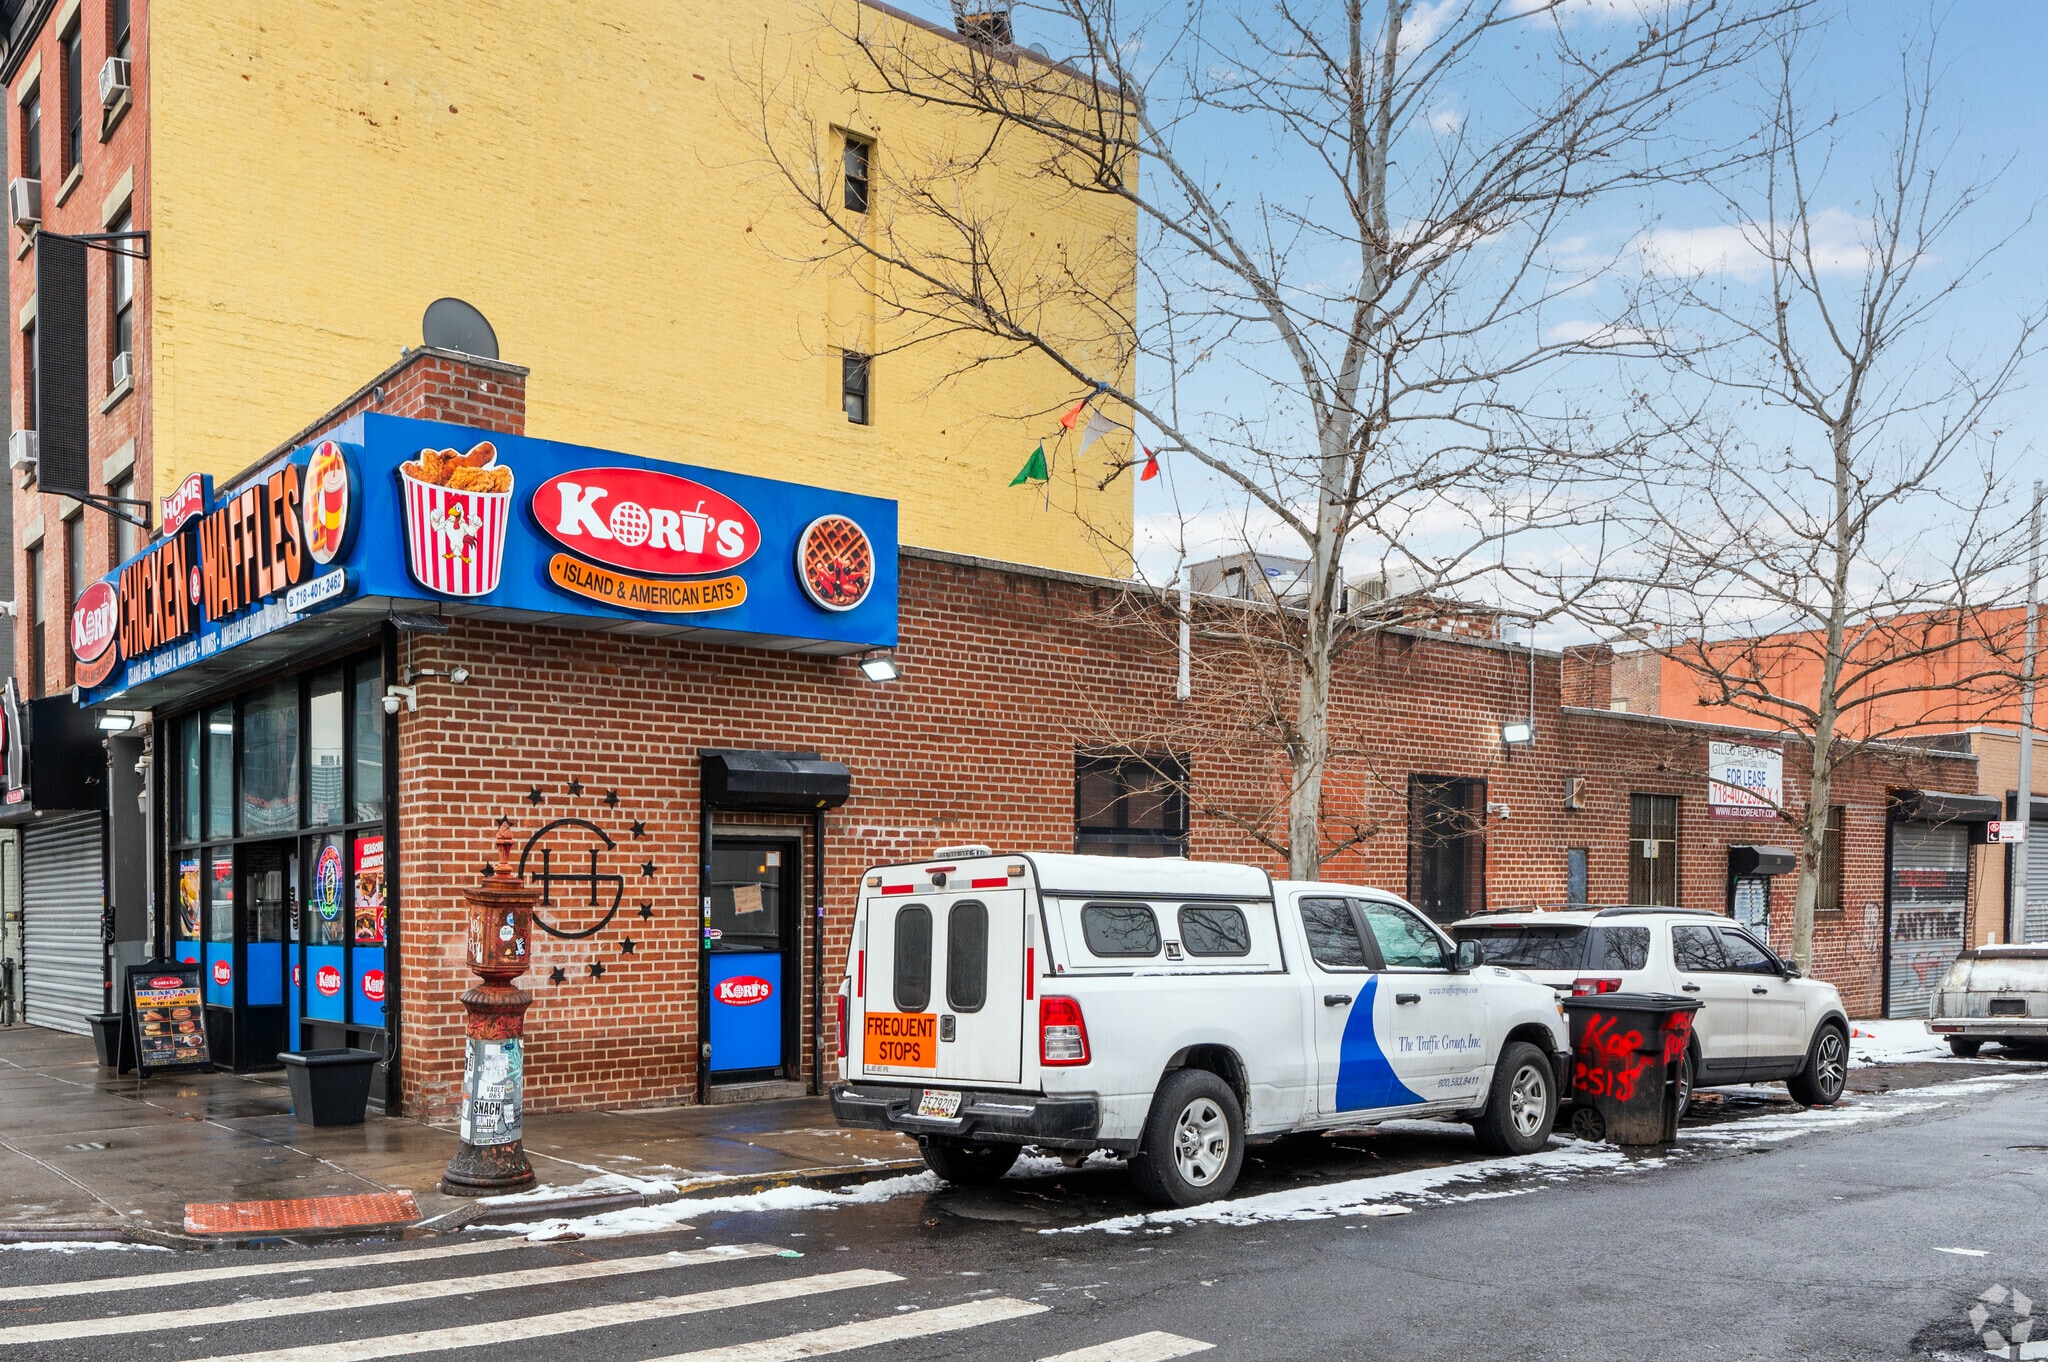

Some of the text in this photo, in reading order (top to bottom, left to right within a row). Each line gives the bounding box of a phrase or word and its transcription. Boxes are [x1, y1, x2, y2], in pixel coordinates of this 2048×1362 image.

[163, 479, 201, 520] HOME
[175, 511, 186, 525] OF
[199, 463, 301, 623] WAFFLES
[563, 562, 734, 606] ISLAND & AMERICAN EATS
[119, 532, 189, 661] CHICKEN
[192, 573, 200, 598] &
[1727, 768, 1766, 787] FOR LEASE
[137, 988, 197, 997] BREAKFAST
[151, 992, 187, 1002] SPECIAL
[867, 1017, 935, 1037] FREQUENT
[879, 1041, 921, 1062] STOPS
[1398, 1033, 1481, 1055] The Traffic Group, Inc.
[866, 1065, 889, 1073] LEER
[486, 1085, 505, 1093] VAULT
[473, 1100, 501, 1116] SNACH
